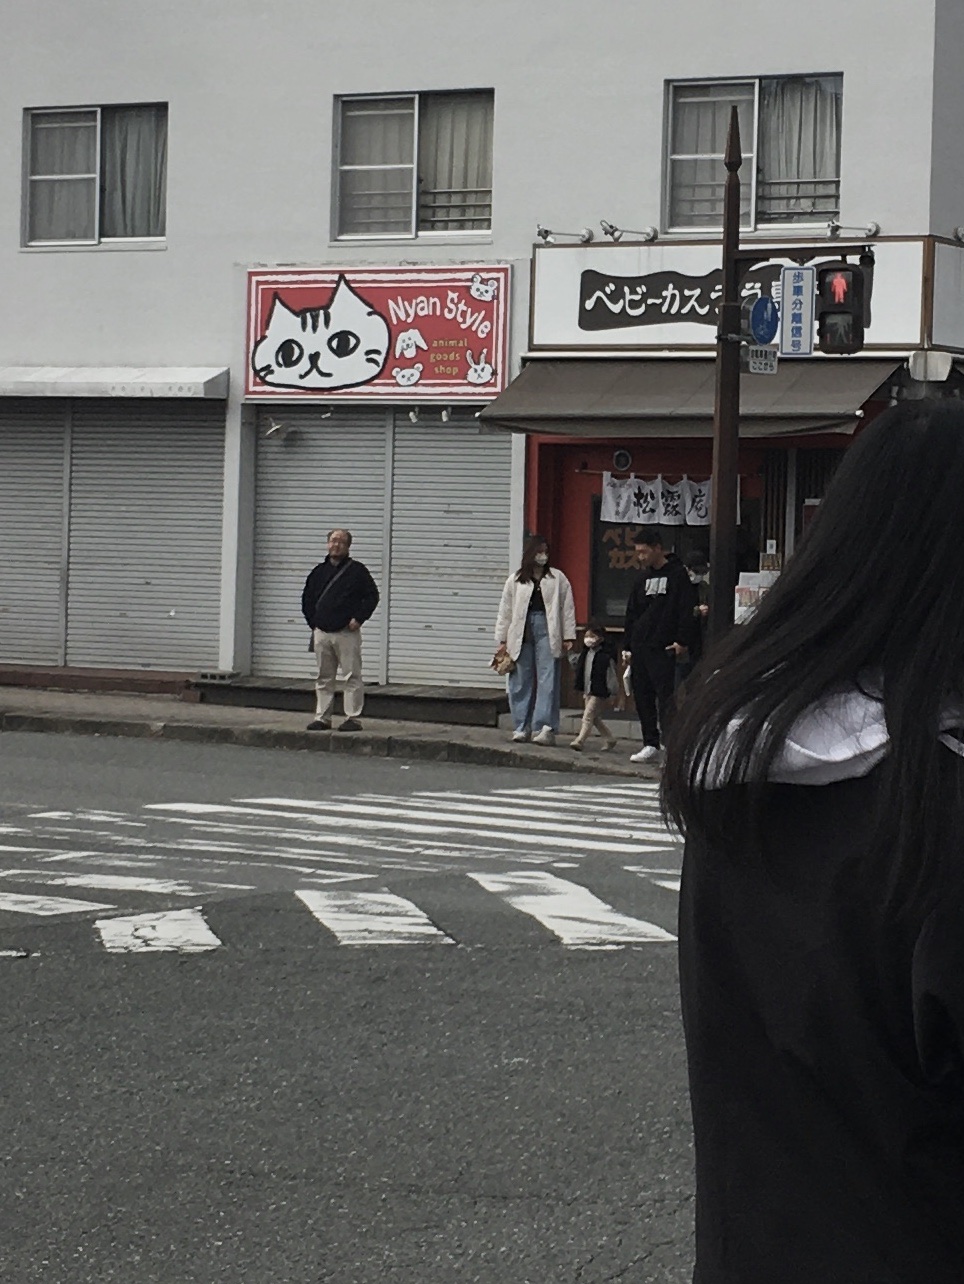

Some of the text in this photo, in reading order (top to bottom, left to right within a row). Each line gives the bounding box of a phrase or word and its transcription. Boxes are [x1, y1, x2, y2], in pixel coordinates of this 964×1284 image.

[387, 289, 491, 339] Nyan Style
[791, 271, 804, 352] 歩車分離信号
[432, 337, 468, 347] animal
[429, 351, 461, 362] goods
[434, 365, 459, 375] shop
